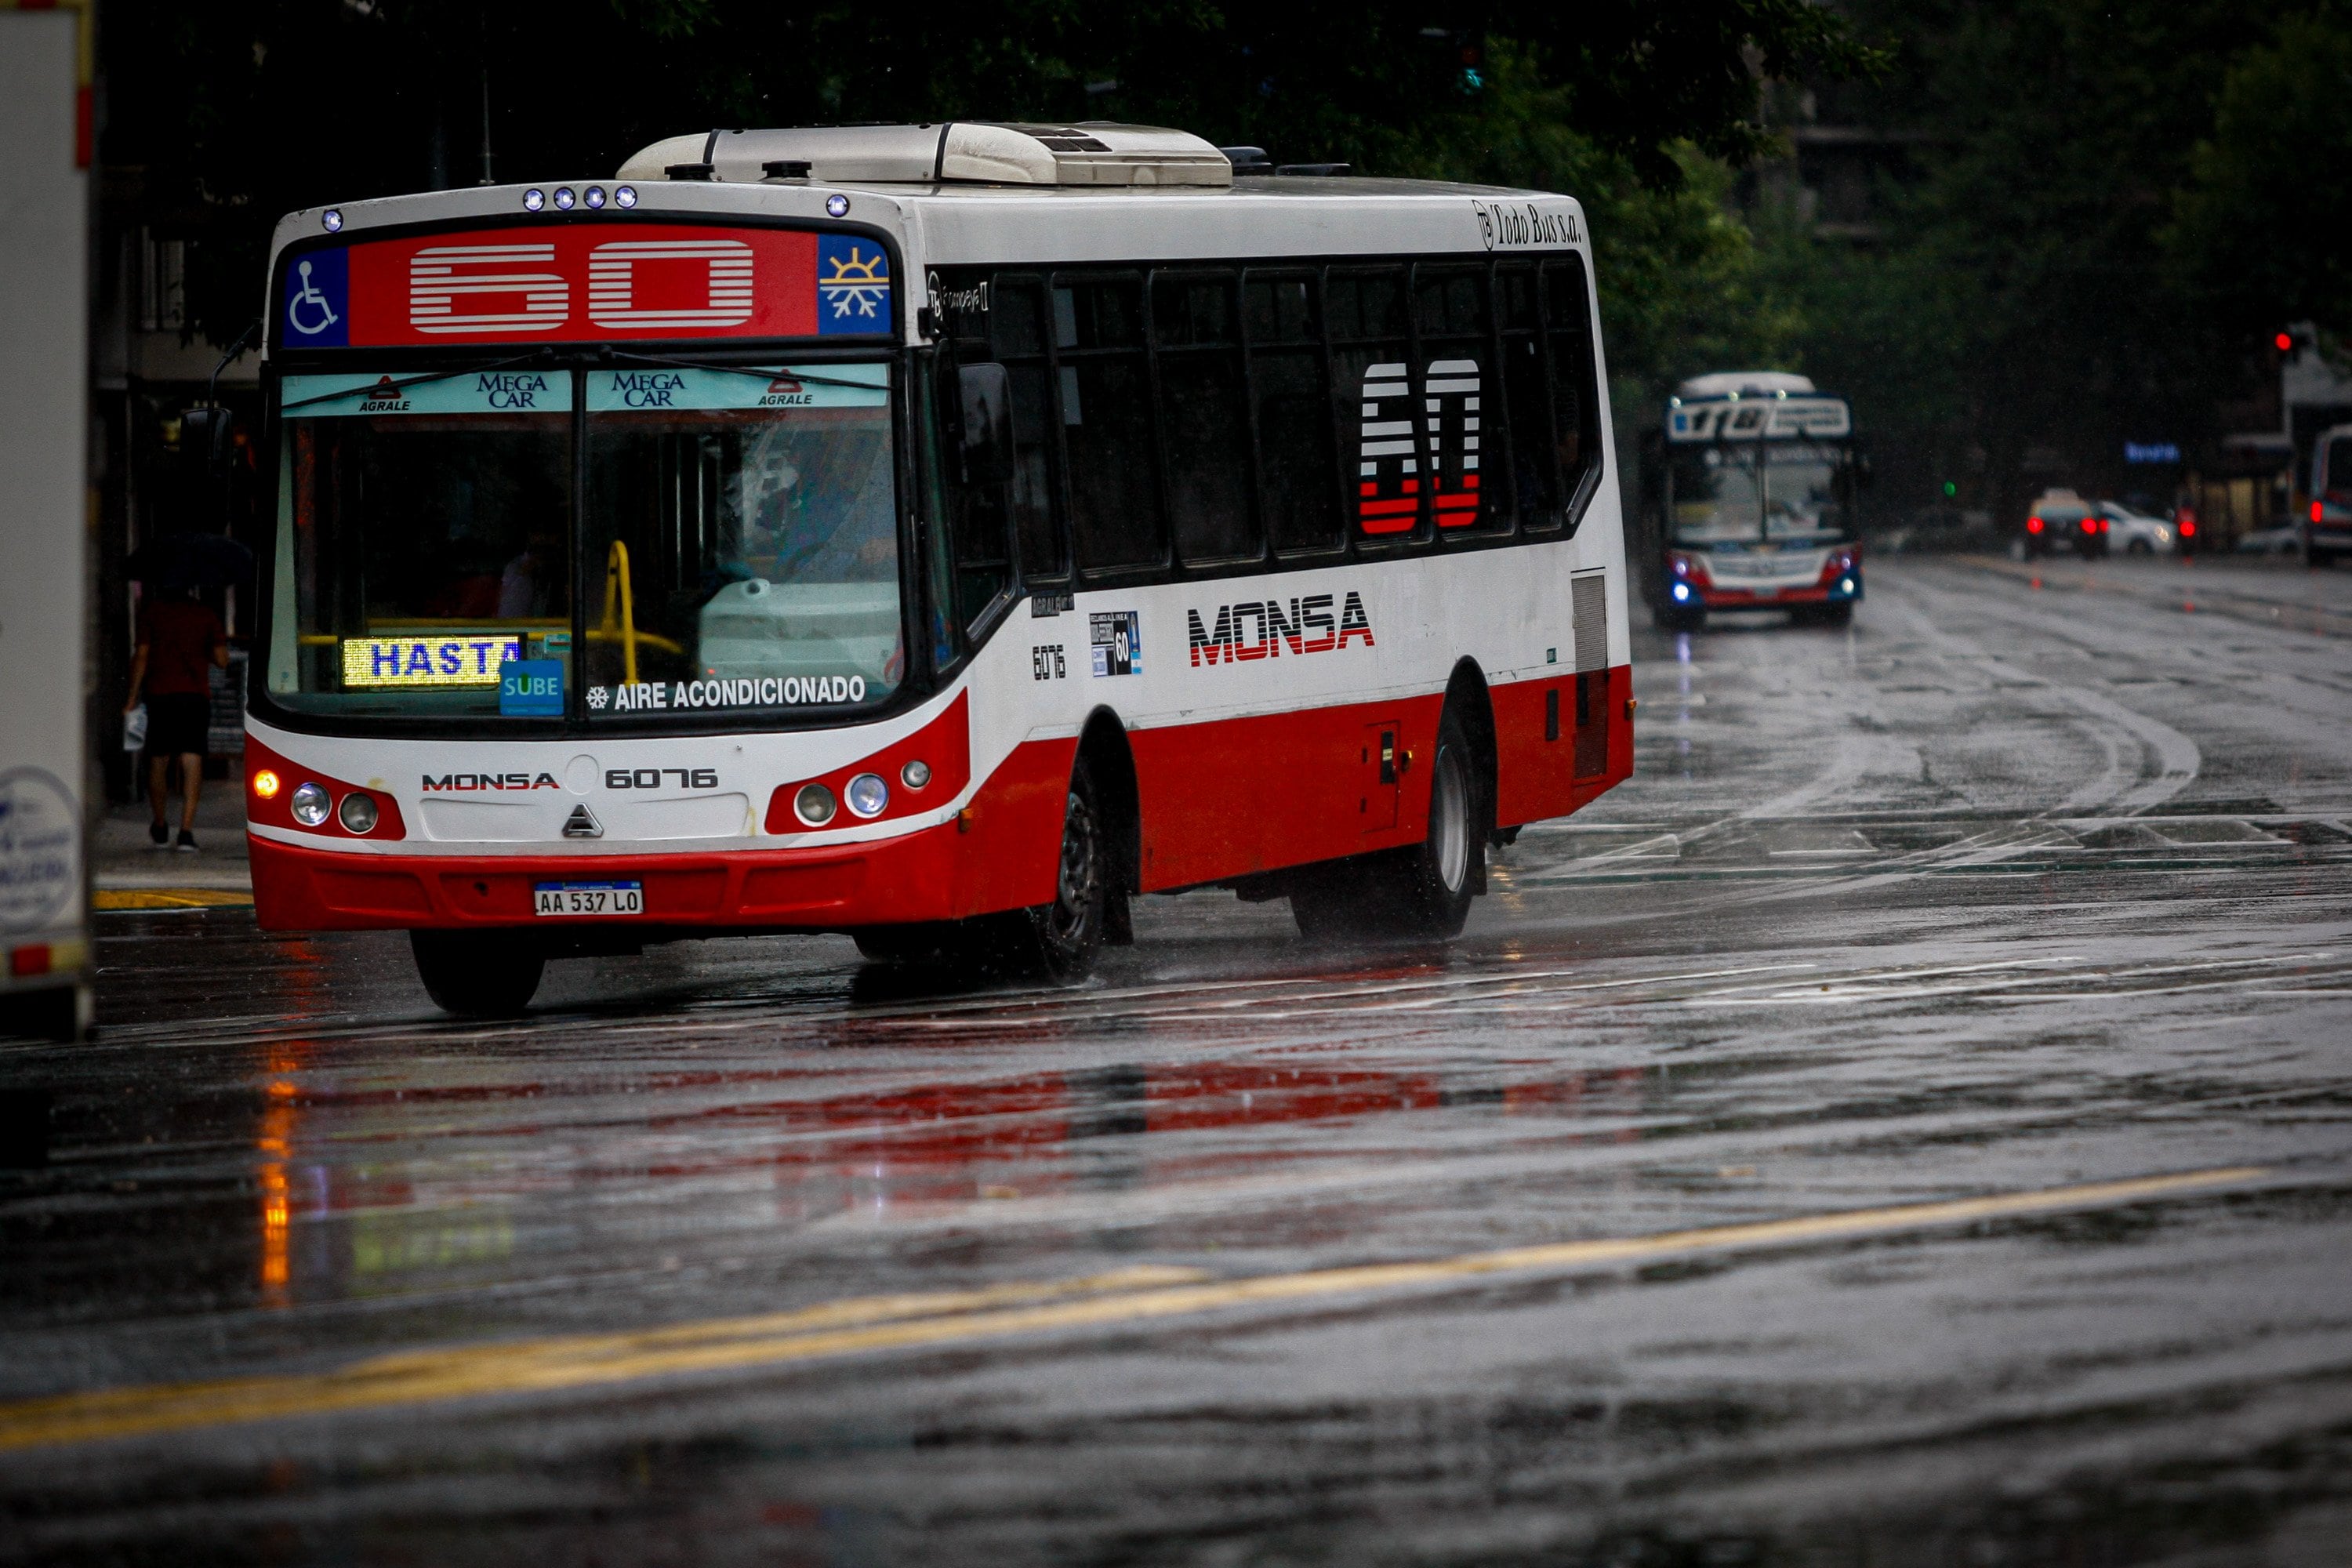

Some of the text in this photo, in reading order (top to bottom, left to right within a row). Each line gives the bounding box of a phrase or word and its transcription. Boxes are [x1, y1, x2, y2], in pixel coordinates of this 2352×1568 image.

[1490, 204, 1528, 245] Todo
[1527, 204, 1557, 243] Bus
[410, 240, 753, 333] 60
[477, 373, 548, 392] MEGA
[612, 372, 685, 391] MEGA
[360, 401, 411, 412] AGRALE
[488, 391, 535, 408] CAR
[624, 390, 674, 407] CAR
[758, 394, 812, 405] AGRALE
[1359, 359, 1479, 534] 60
[1187, 591, 1375, 667] MONSA
[1115, 632, 1129, 662] 60
[1033, 644, 1065, 681] 6076
[504, 677, 558, 696] SUBE
[615, 675, 865, 710] AIRE ACONDICIONADO
[422, 772, 561, 791] MONSA
[605, 768, 718, 789] 6076
[541, 891, 637, 912] AA 537 LO
